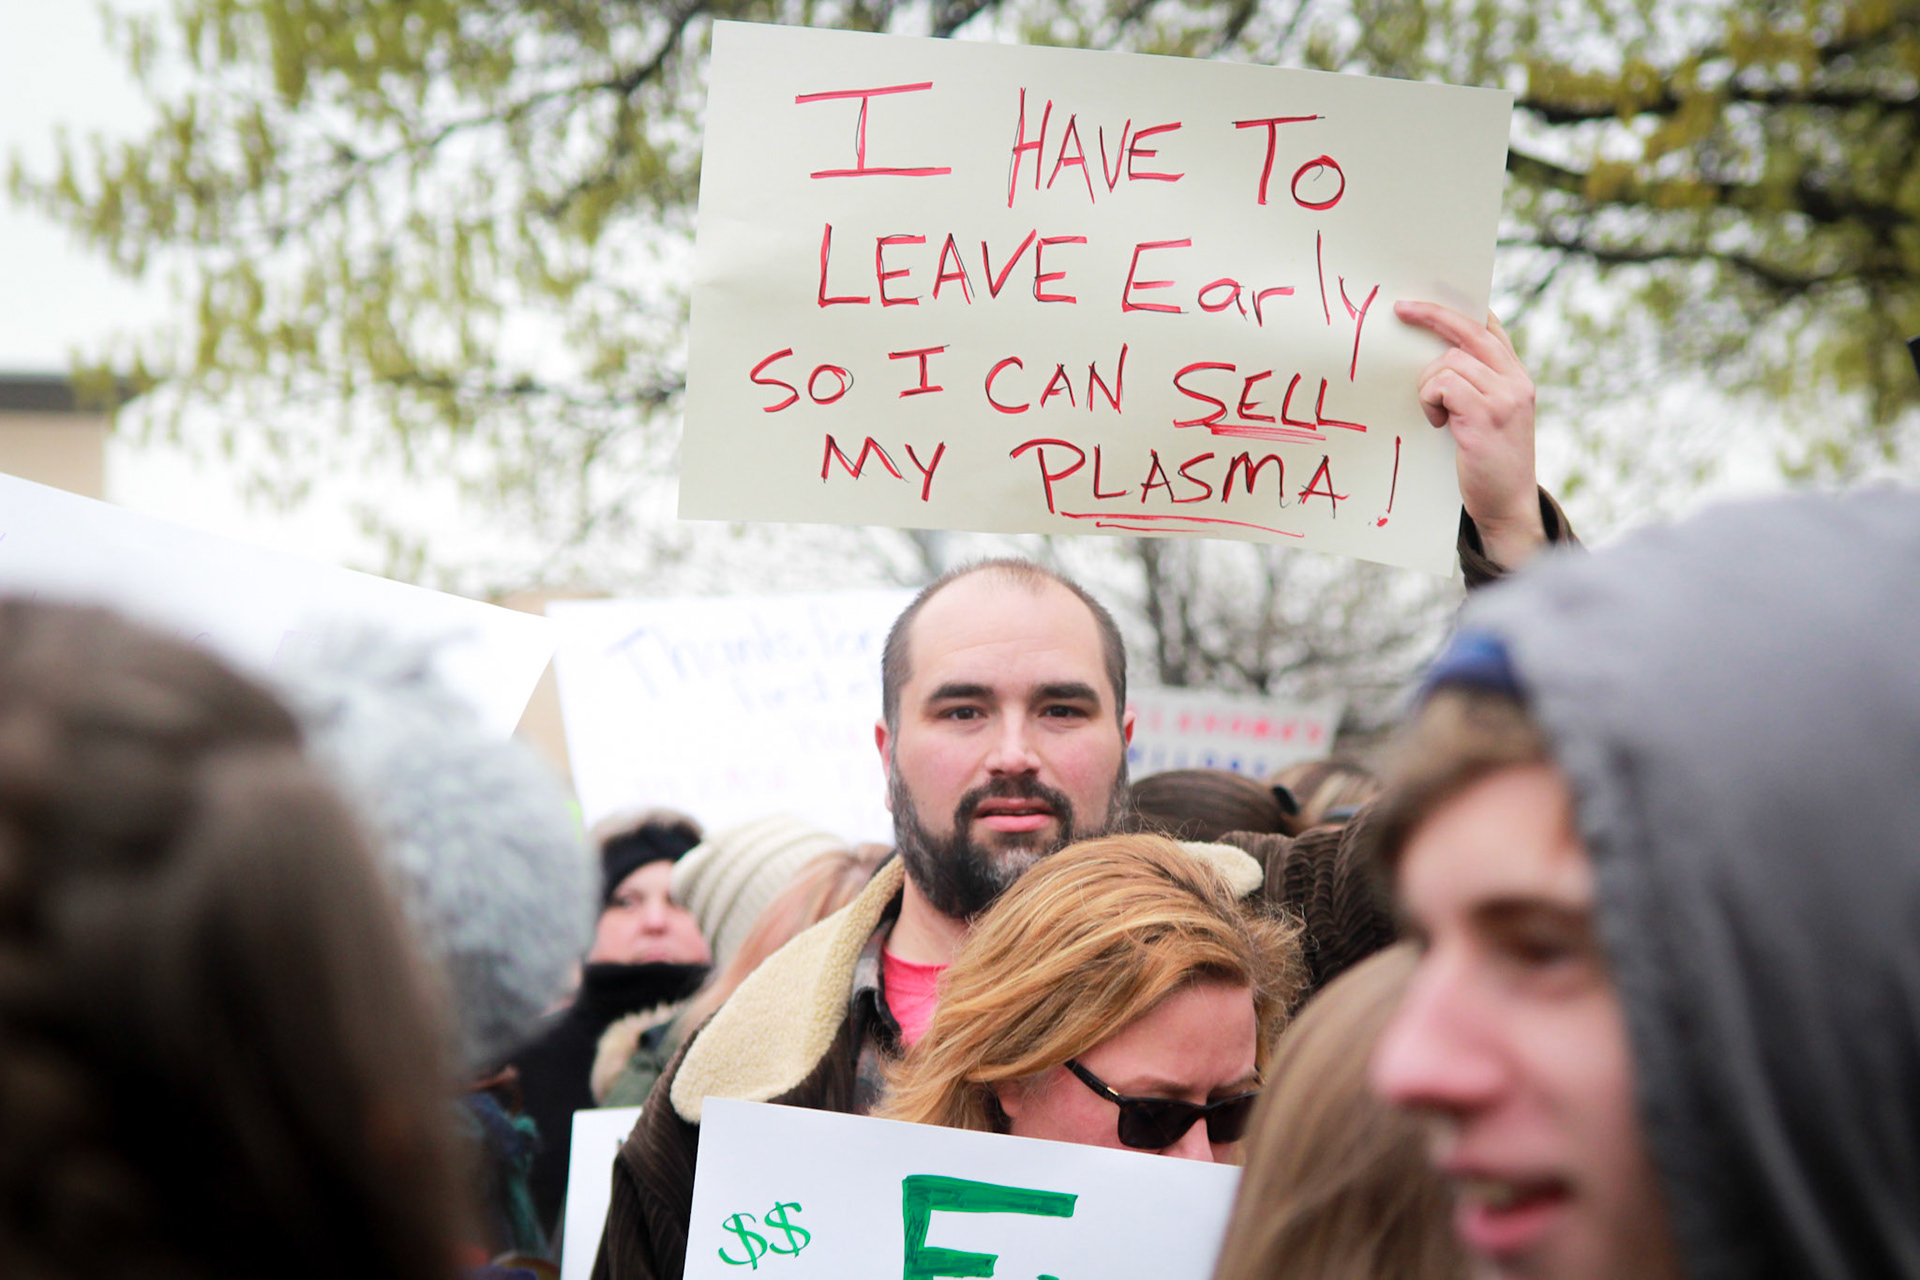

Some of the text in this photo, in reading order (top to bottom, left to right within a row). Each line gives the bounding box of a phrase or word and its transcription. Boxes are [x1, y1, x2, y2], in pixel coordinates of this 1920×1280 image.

[794, 82, 952, 180] I
[1007, 86, 1185, 209] HAVE
[817, 222, 1380, 383] LEAVE Early
[887, 344, 950, 399] I
[984, 342, 1131, 415] CAN
[1172, 361, 1368, 433] SELL
[820, 432, 946, 503] MY
[717, 1200, 812, 1271] $$
